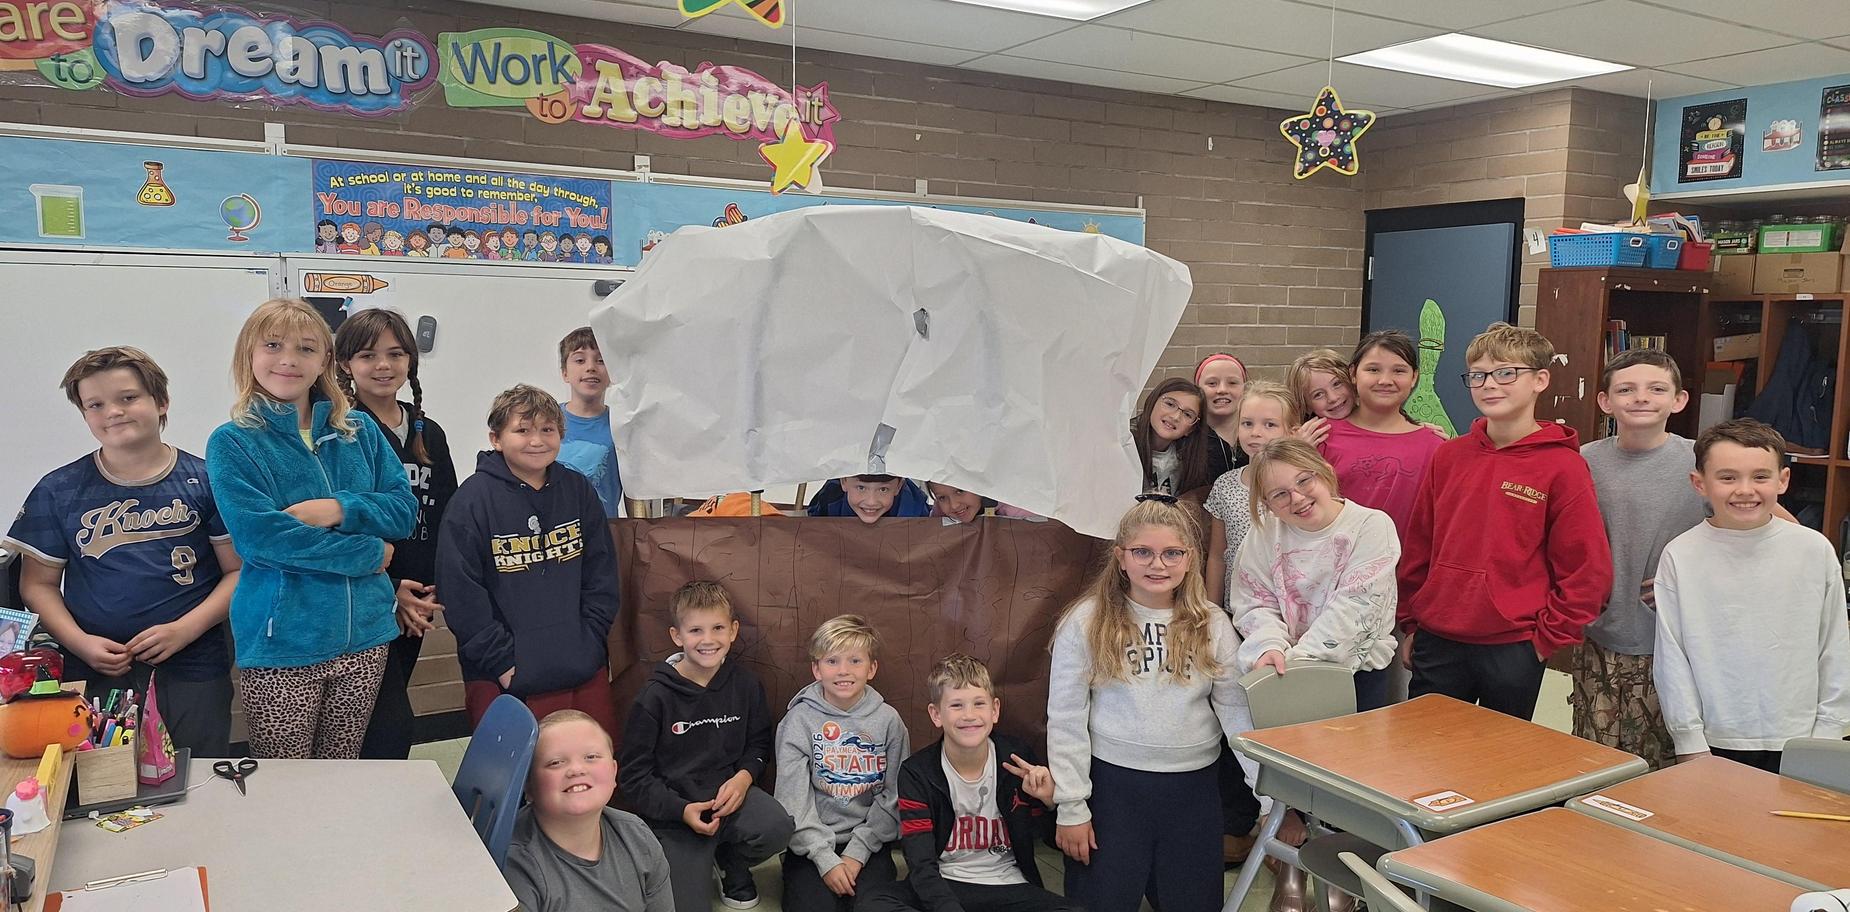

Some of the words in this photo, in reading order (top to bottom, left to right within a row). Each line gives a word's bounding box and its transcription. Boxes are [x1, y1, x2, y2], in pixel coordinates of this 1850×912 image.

[0, 2, 88, 41] are
[52, 53, 94, 85] to
[111, 12, 392, 95] Dream
[394, 40, 421, 80] it
[452, 40, 576, 87] Work
[538, 91, 568, 120] to
[582, 59, 800, 138] Achieve
[806, 91, 824, 126] it
[1827, 94, 1850, 104] CLASS
[1691, 166, 1708, 174] SMILES
[330, 176, 344, 188] At
[349, 171, 389, 186] school
[393, 173, 406, 182] or
[411, 171, 424, 182] at
[428, 171, 461, 183] home
[465, 173, 487, 185] and
[491, 174, 503, 186] all
[507, 177, 525, 189] the
[529, 182, 550, 197] day
[554, 186, 599, 209] through,
[403, 183, 422, 194] It's
[426, 186, 457, 198] good
[461, 187, 474, 198] to
[478, 189, 538, 203] remember,
[317, 192, 361, 216] You
[367, 200, 400, 218] are
[403, 197, 528, 225] Responsible
[531, 205, 562, 227] for
[565, 207, 609, 230] You!
[76, 499, 201, 559] Knoch
[171, 545, 197, 586] 9
[671, 714, 741, 735] Champion
[813, 733, 824, 769] 2026
[824, 755, 886, 773] STATE
